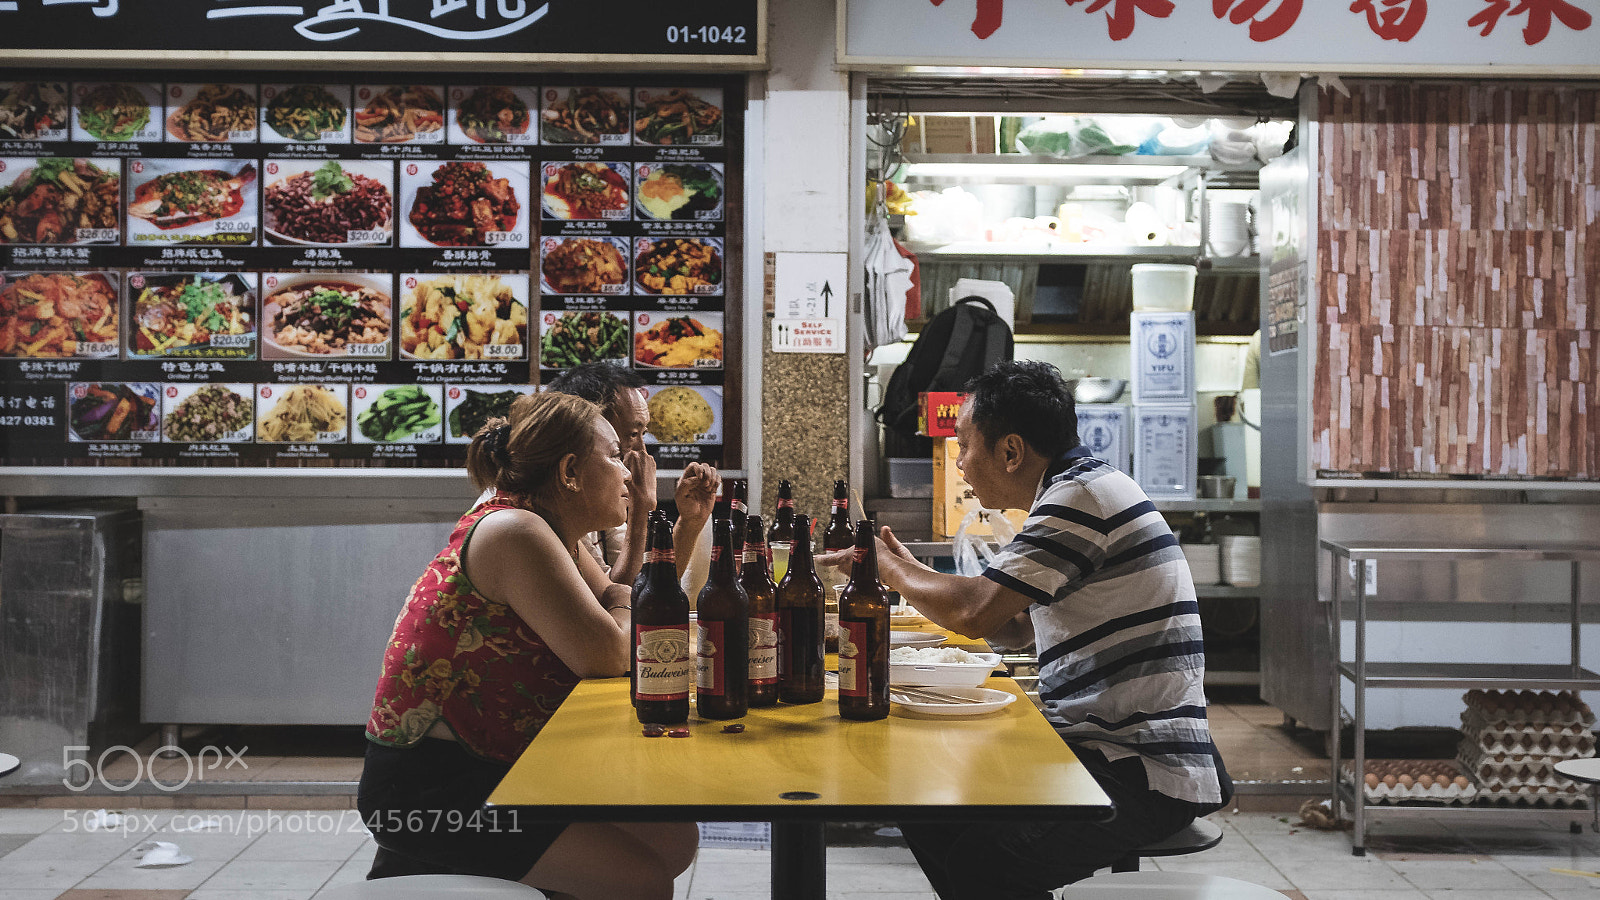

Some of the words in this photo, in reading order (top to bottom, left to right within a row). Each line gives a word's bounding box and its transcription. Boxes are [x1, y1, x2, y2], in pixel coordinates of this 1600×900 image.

[666, 25, 746, 43] 01-1042
[215, 222, 250, 232] $20.00
[349, 231, 384, 241] $20.00
[488, 233, 522, 243] $13.00
[12, 247, 92, 259] 招牌香辣蟹
[161, 248, 224, 259] 招牌纸包鱼
[13, 258, 47, 266] Signature
[48, 258, 67, 266] Spicy
[213, 335, 249, 345] $20.00
[79, 342, 114, 352] $16.00
[350, 345, 385, 355] $16.00
[489, 345, 519, 355] $8.00
[19, 361, 81, 372] 香辣干锅虾
[161, 362, 226, 372] 特色烤鱼
[412, 363, 508, 374] 干锅有机菜花
[1151, 364, 1175, 372] YIFU
[24, 417, 56, 426] 0381
